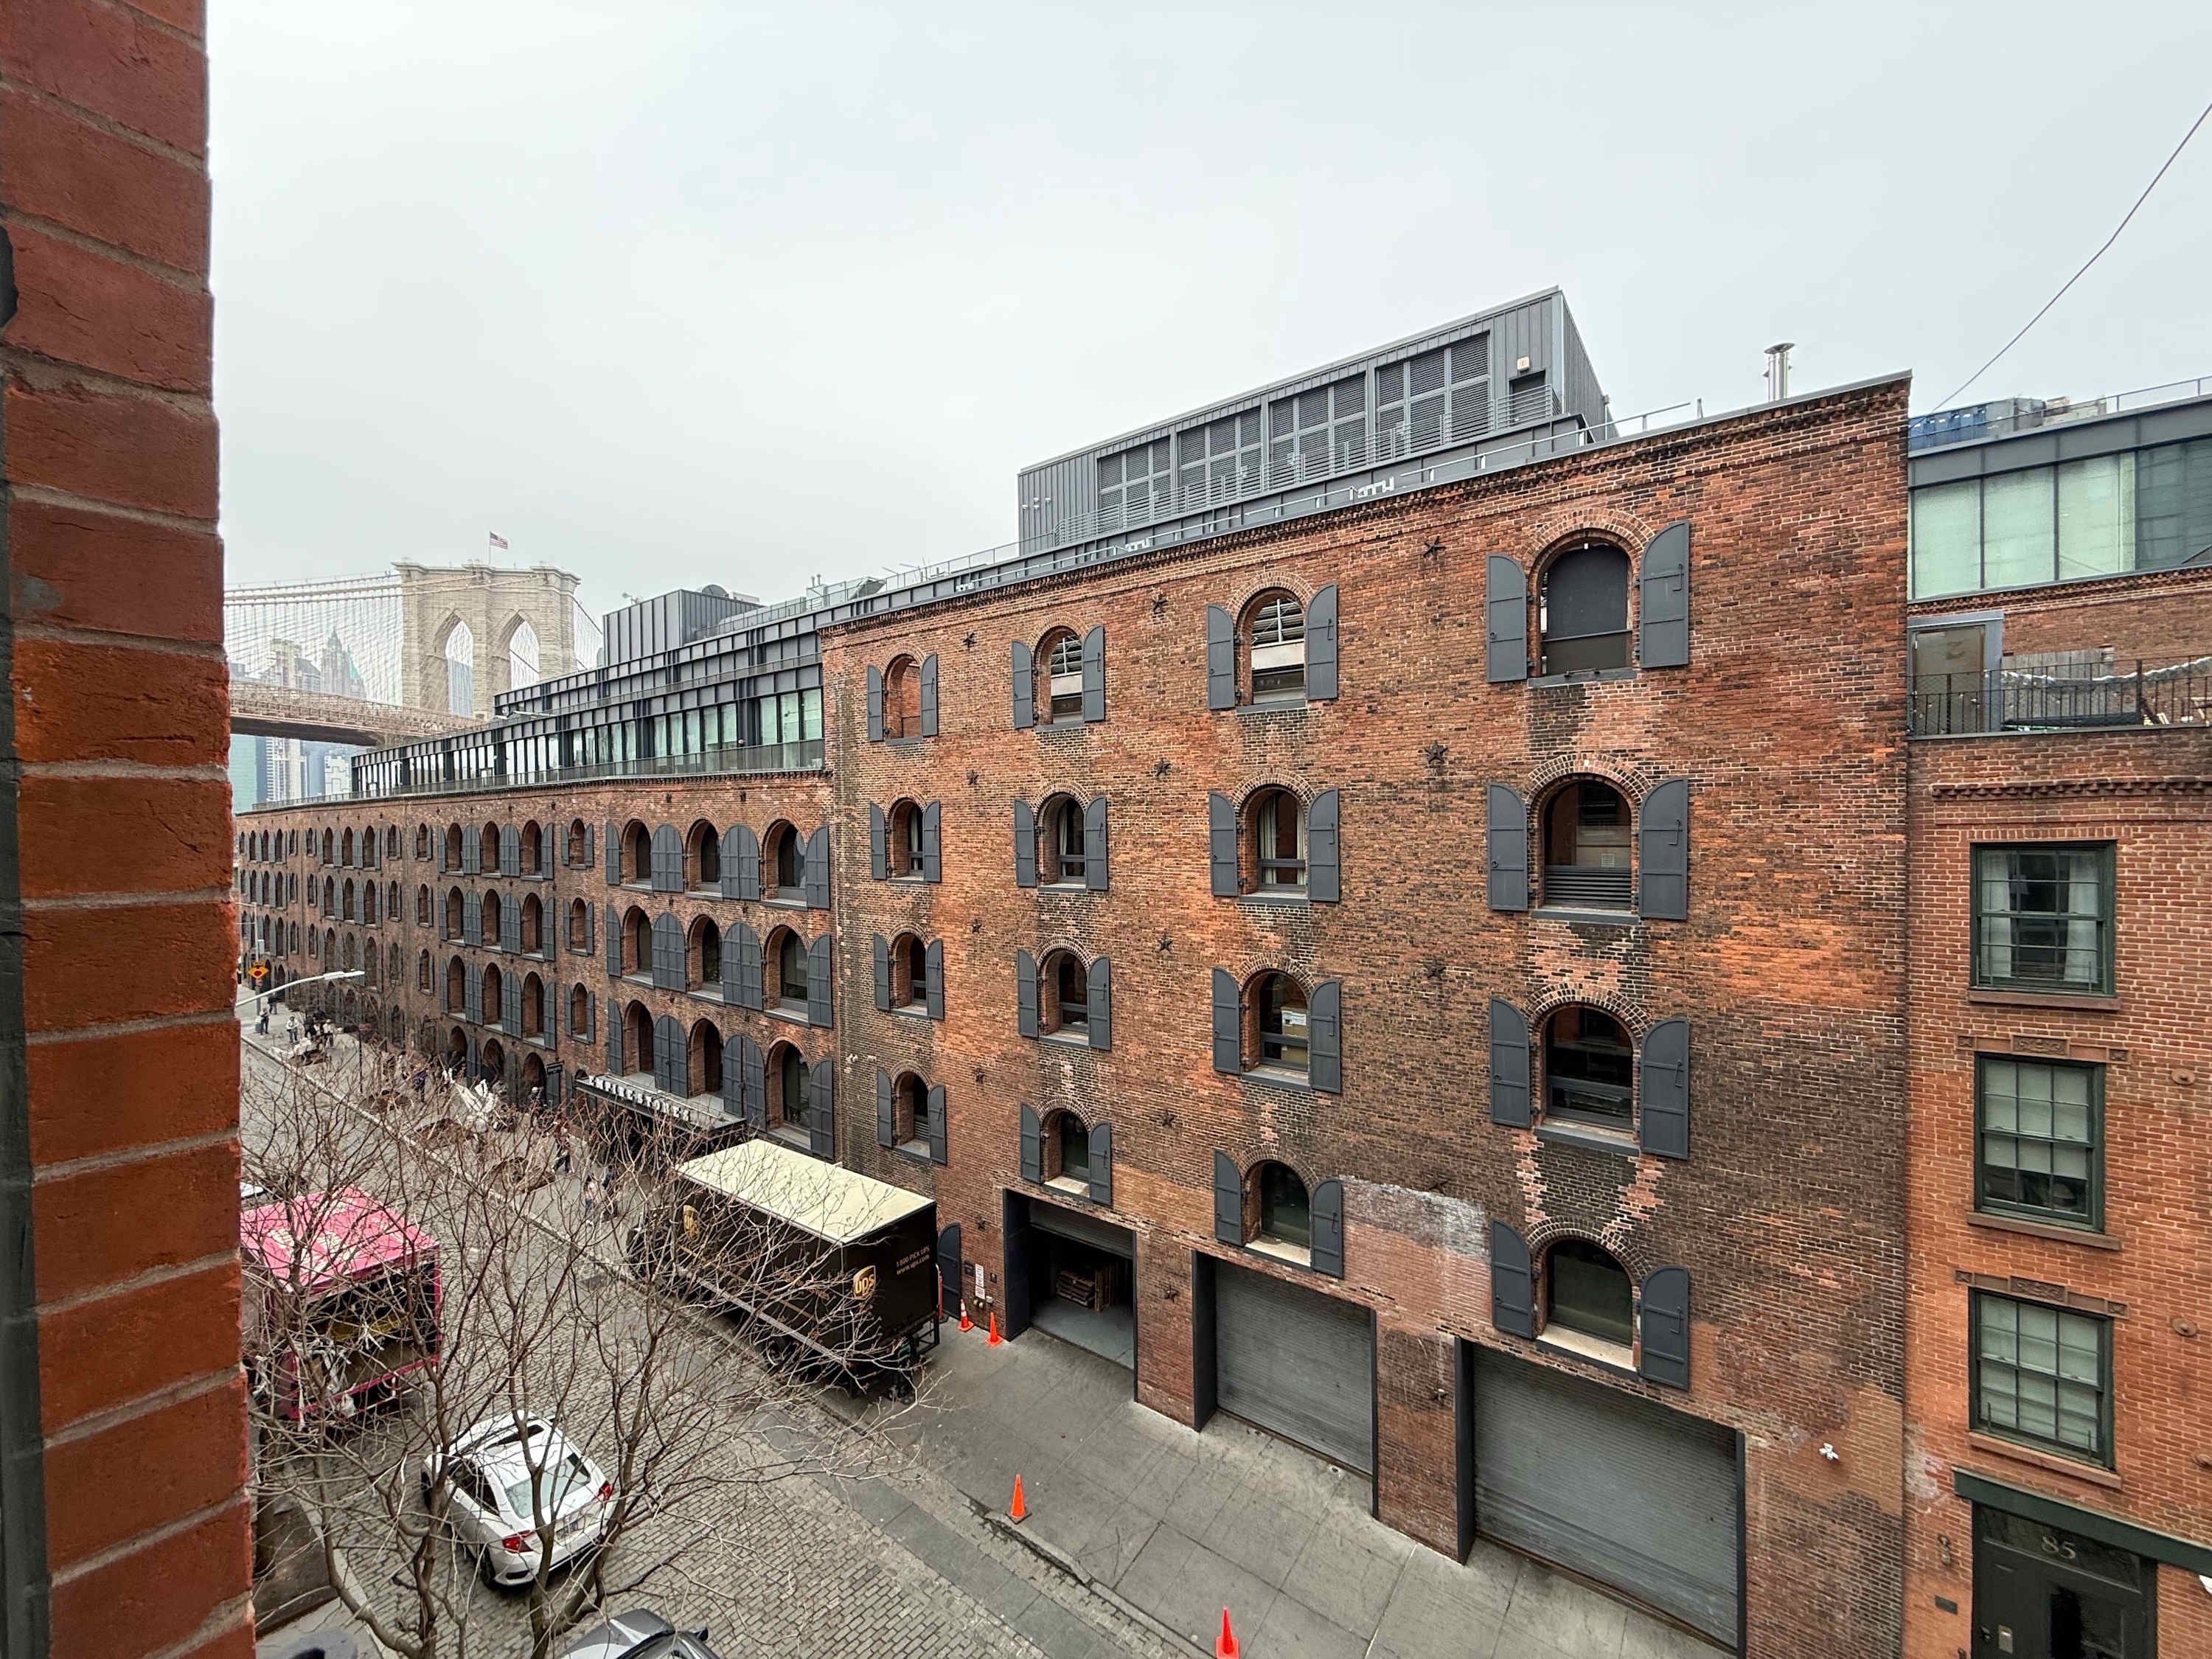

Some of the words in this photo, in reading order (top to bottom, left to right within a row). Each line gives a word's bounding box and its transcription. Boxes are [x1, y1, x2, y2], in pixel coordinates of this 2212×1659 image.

[589, 1075, 635, 1101] EMPIRE
[855, 1274, 875, 1296] ups
[2042, 1535, 2076, 1559] 85
